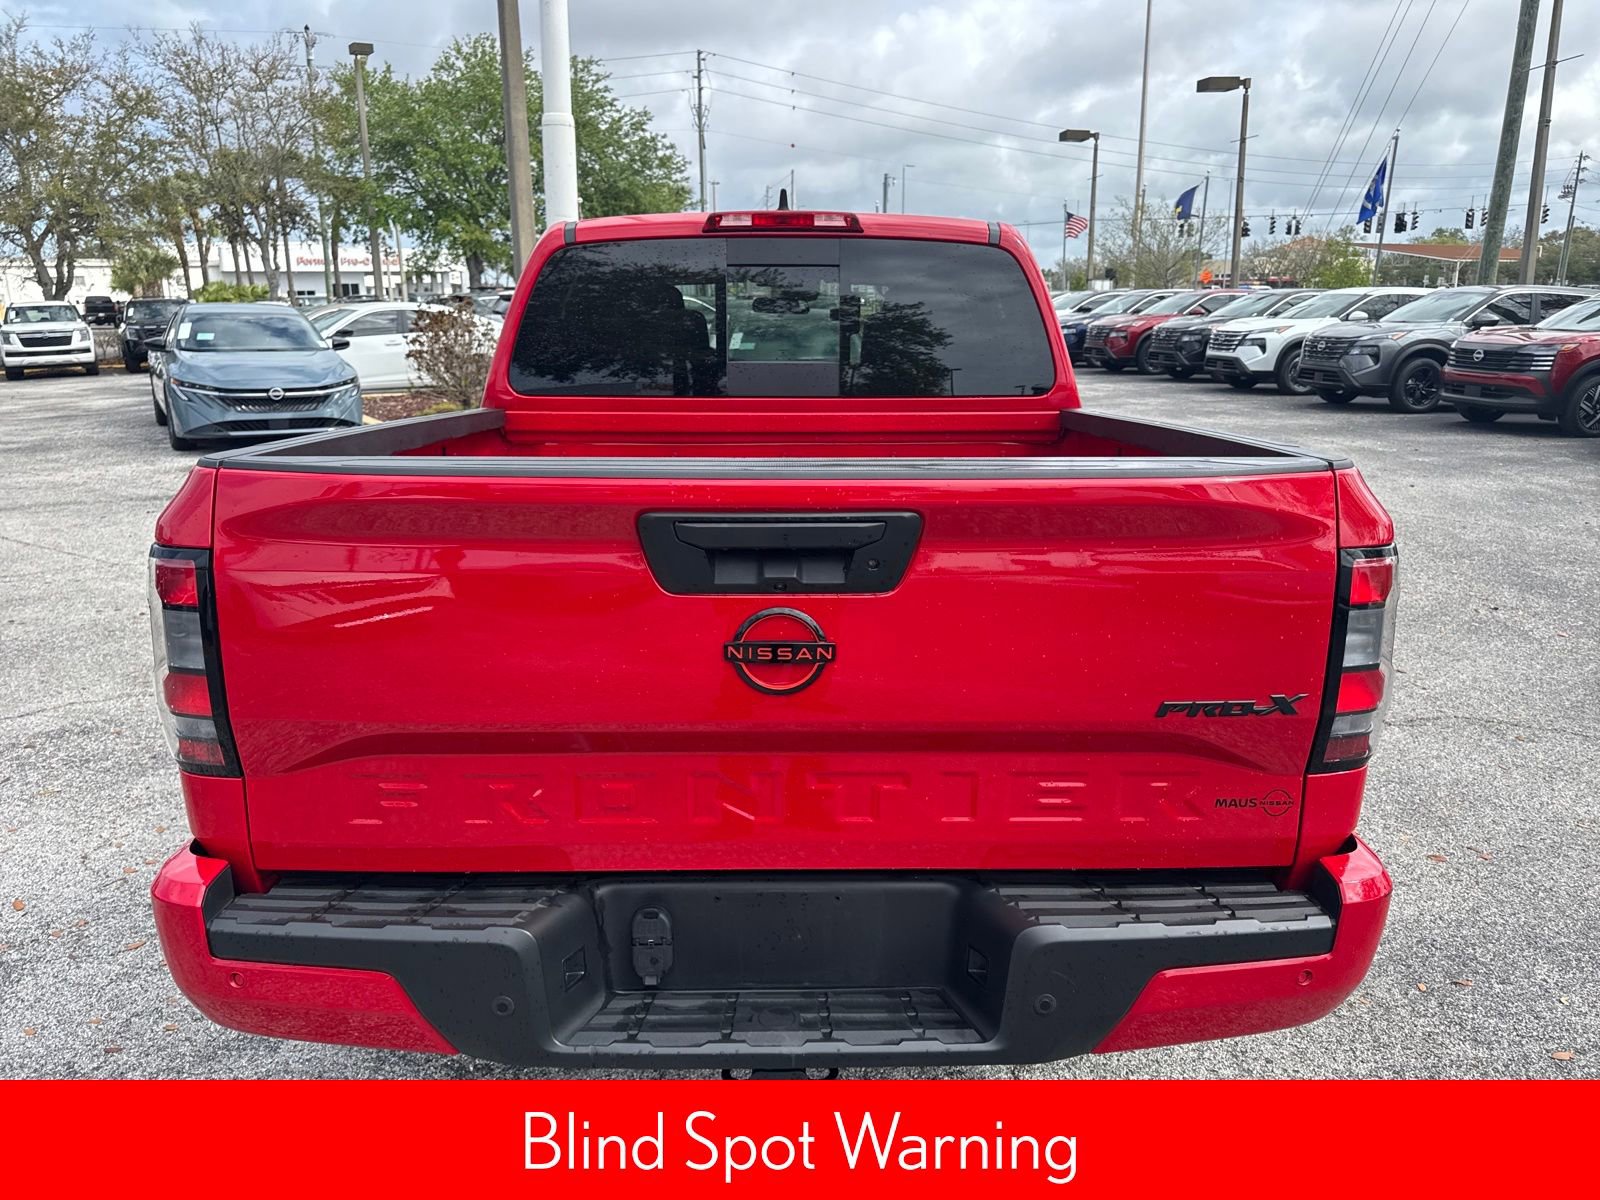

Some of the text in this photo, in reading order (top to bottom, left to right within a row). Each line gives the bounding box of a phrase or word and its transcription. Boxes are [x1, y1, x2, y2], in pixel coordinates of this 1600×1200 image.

[727, 646, 833, 660] NISSAN
[347, 771, 1206, 824] FRONTIER
[1214, 798, 1257, 809] MAUS
